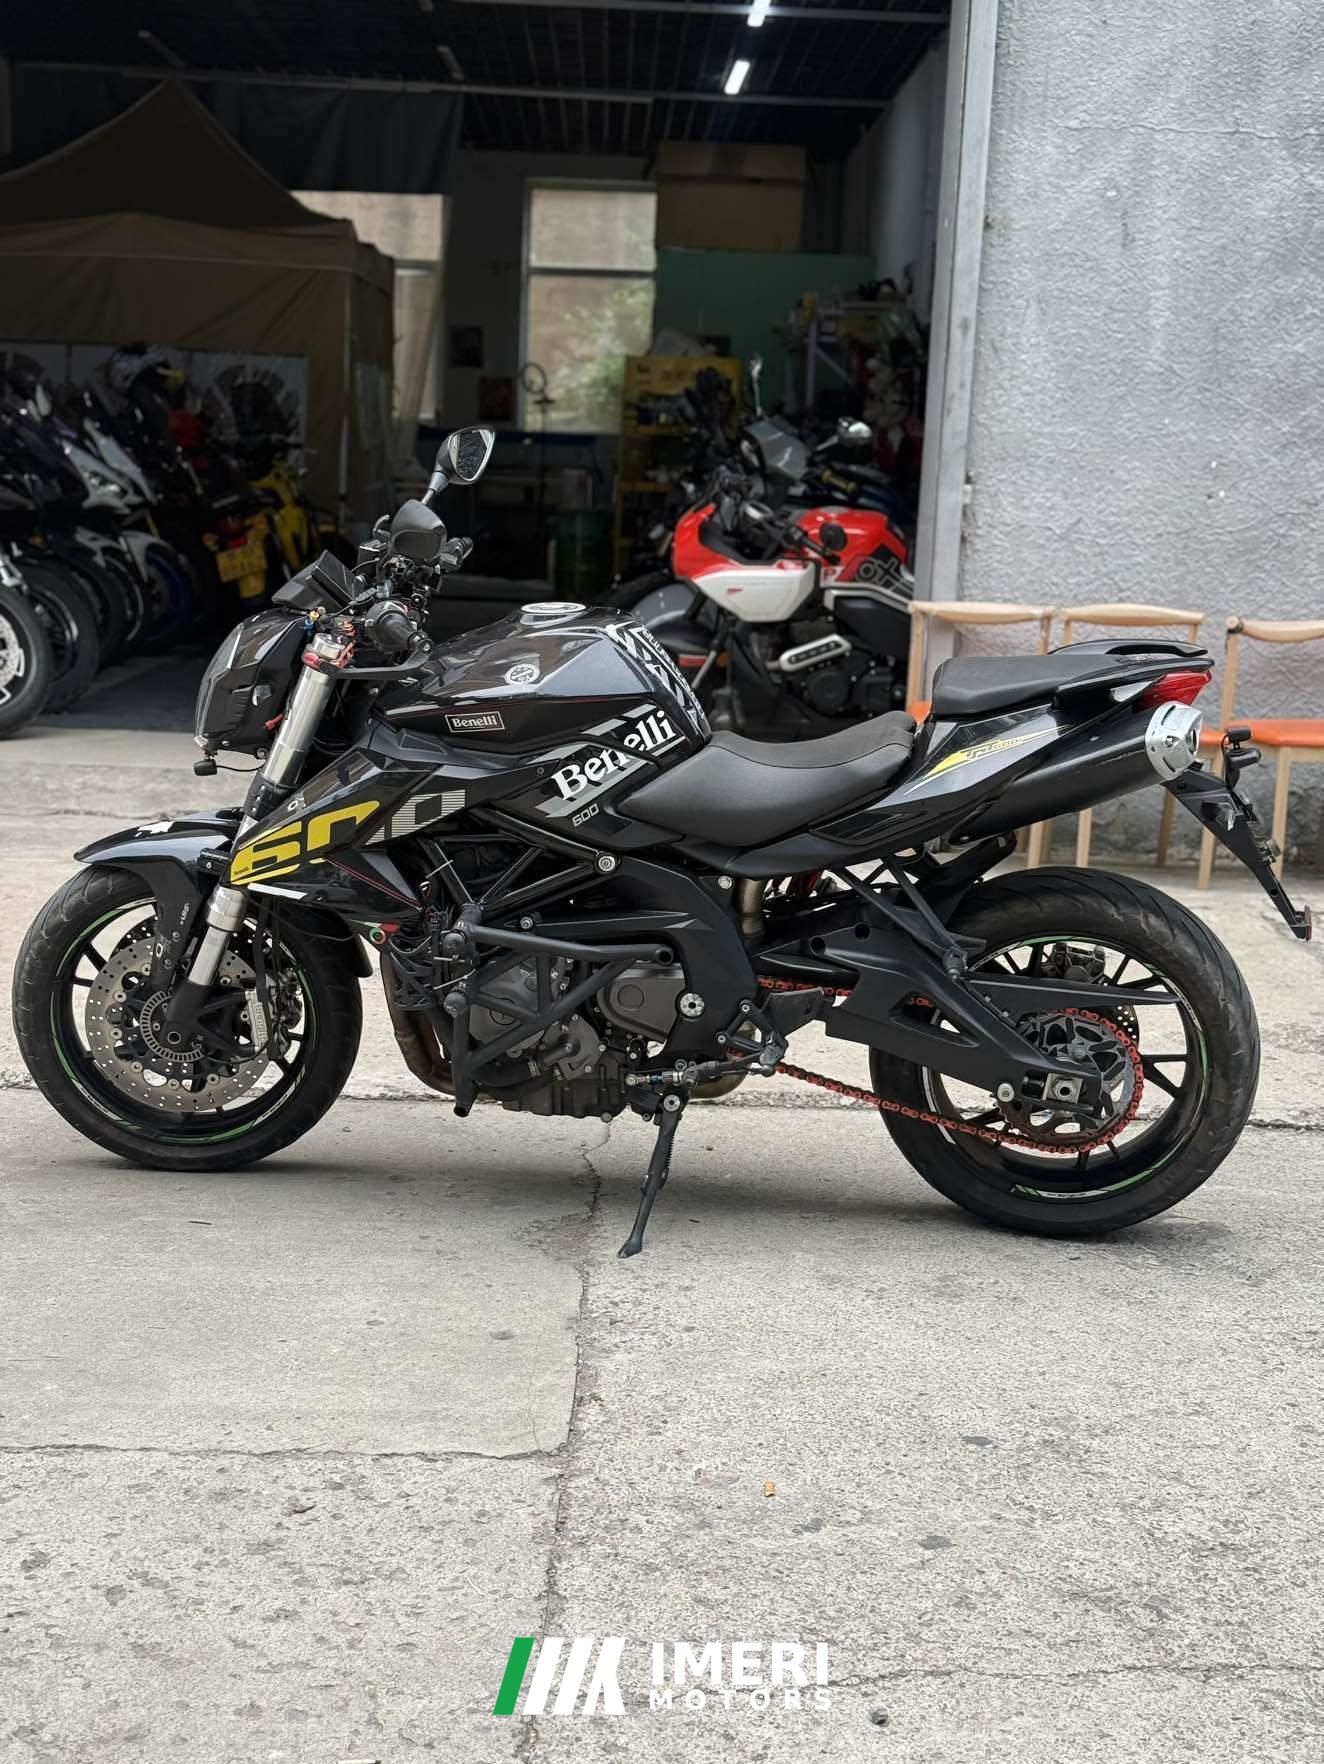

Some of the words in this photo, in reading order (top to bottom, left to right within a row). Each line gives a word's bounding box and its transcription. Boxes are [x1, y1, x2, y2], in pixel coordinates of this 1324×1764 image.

[451, 715, 498, 728] Benelli
[551, 710, 677, 801] Benelli
[571, 803, 600, 827] 600
